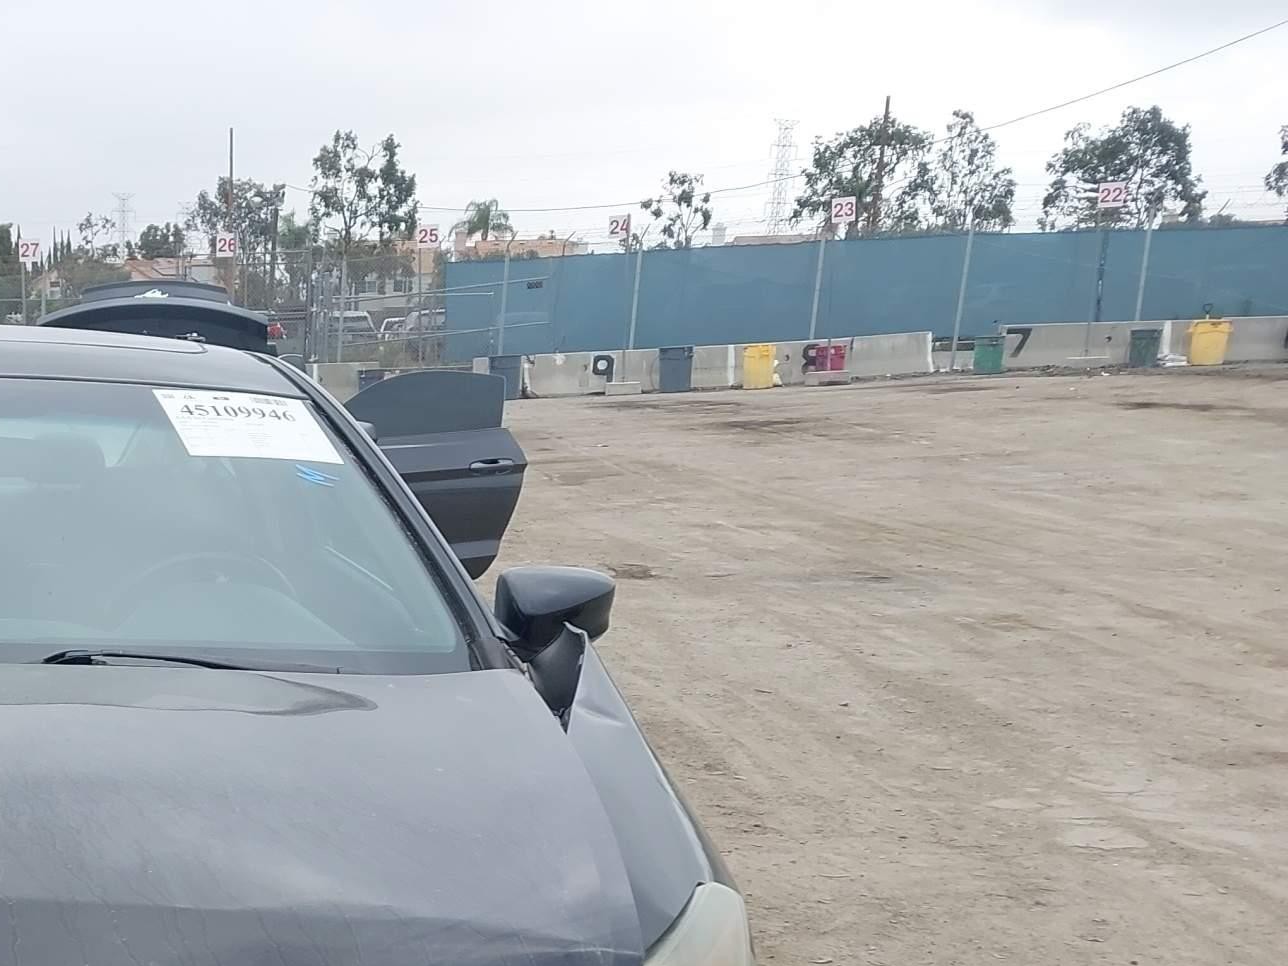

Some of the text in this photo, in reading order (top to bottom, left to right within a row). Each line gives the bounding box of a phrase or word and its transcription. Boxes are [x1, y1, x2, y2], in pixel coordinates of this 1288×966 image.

[1100, 187, 1123, 203] 22
[833, 201, 855, 218] 23
[609, 218, 629, 235] 24
[418, 228, 439, 244] 25
[20, 242, 40, 258] 27
[218, 237, 237, 253] 26
[1006, 327, 1033, 358] 7
[179, 403, 297, 422] 45109946
